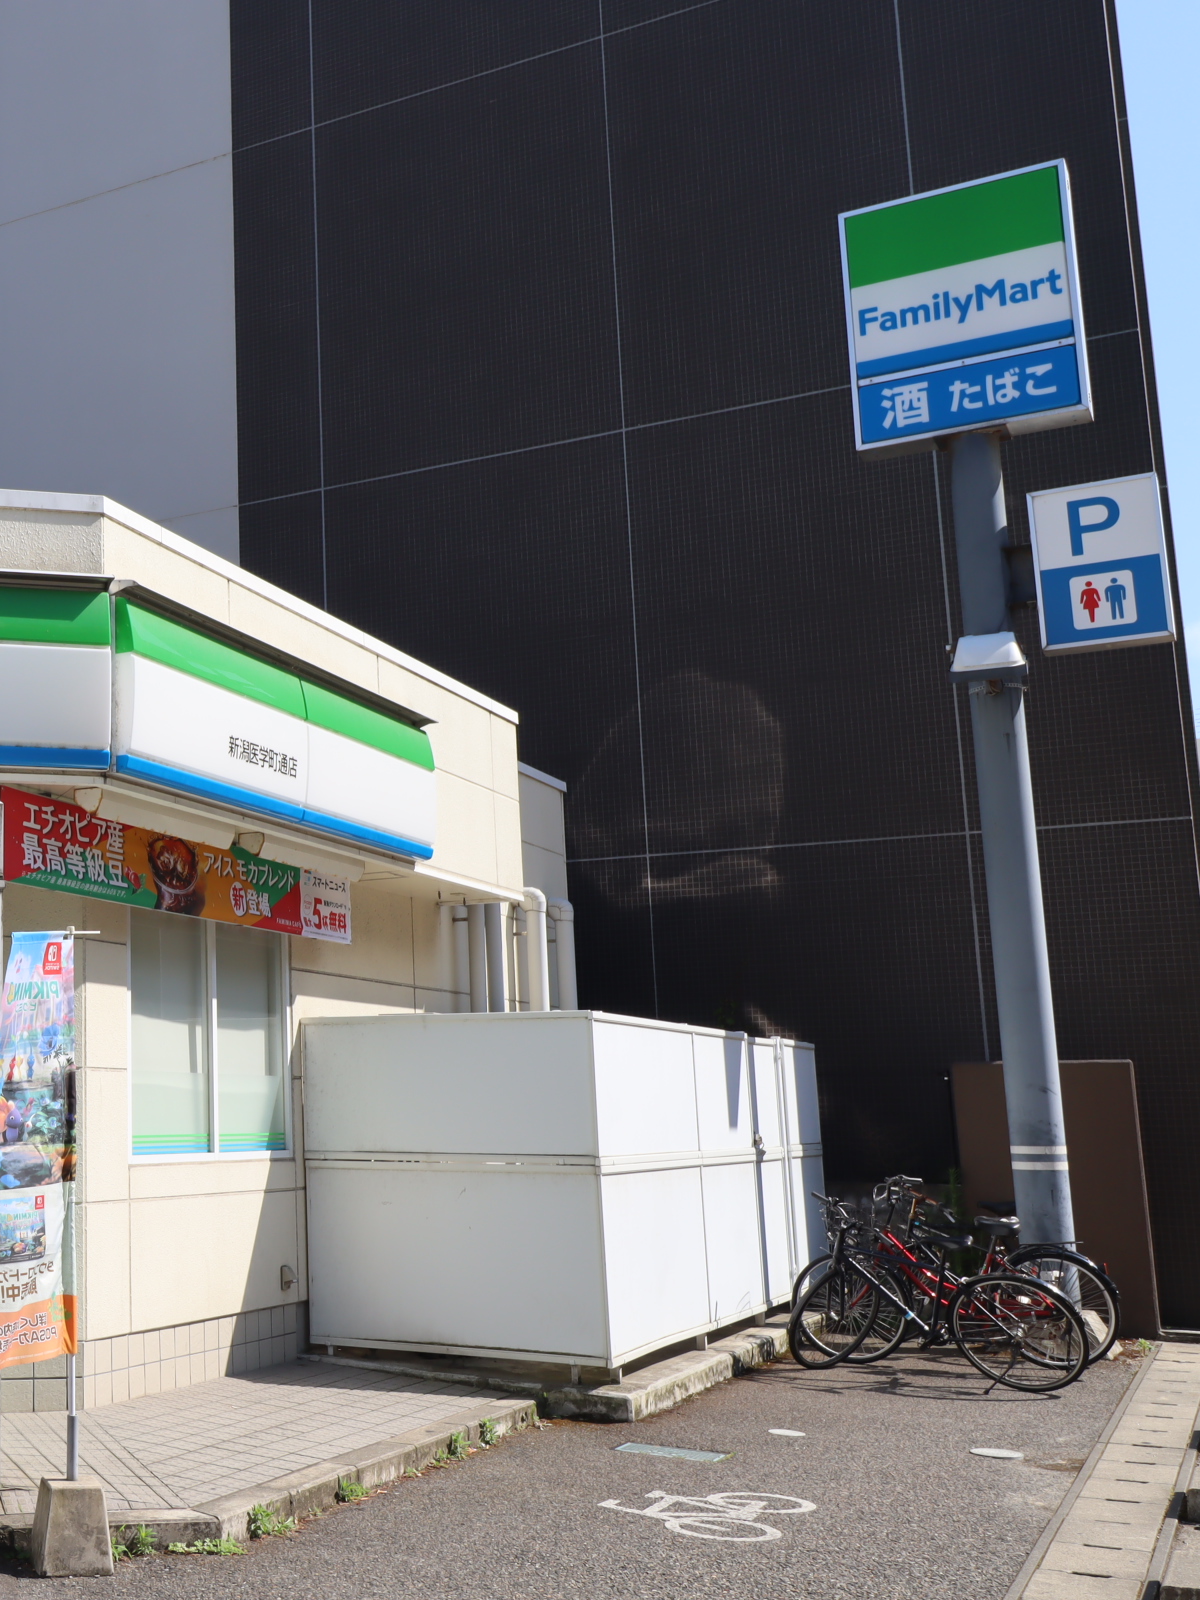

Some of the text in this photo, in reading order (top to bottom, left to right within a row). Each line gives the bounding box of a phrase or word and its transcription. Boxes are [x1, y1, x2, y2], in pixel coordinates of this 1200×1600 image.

[858, 268, 1063, 336] FamilyMart
[881, 363, 1057, 429] 酒 たばこ
[1067, 496, 1120, 556] P
[228, 735, 298, 779] 新潟医学町通店
[22, 802, 124, 854] エチオピア産
[21, 832, 129, 888] 最高等級豆
[203, 852, 295, 893] アイス モカブレンド
[312, 876, 346, 893] スマートニュース
[231, 884, 272, 918] 新登場
